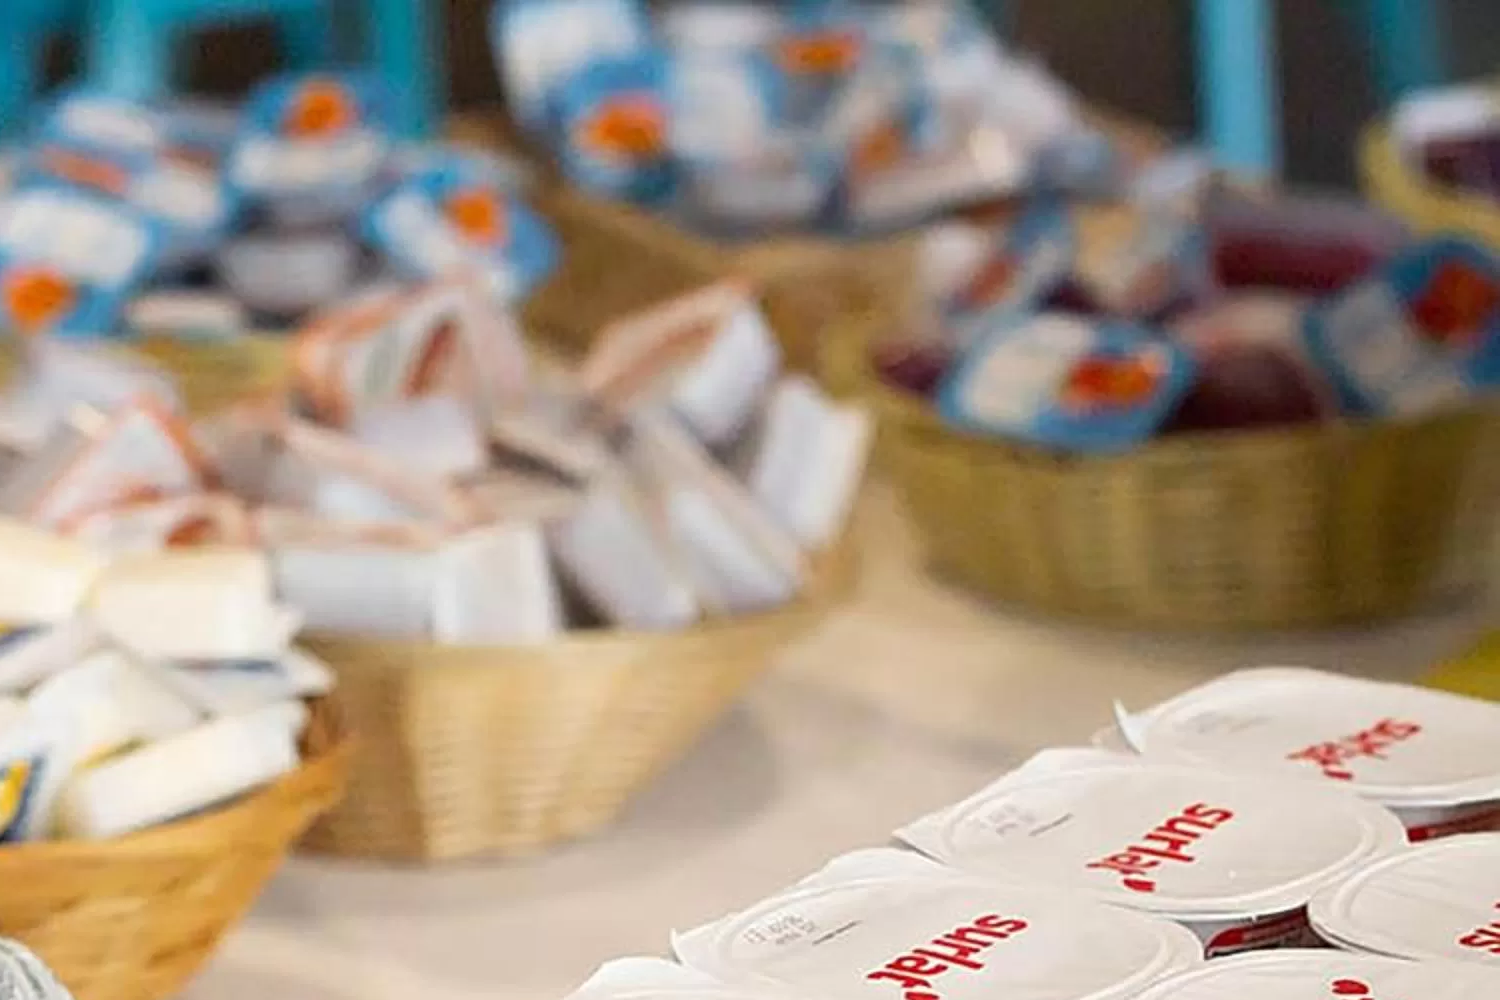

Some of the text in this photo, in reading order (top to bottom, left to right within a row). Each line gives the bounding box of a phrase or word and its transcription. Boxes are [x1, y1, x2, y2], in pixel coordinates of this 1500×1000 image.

[1287, 719, 1420, 767] surlat
[1087, 802, 1235, 883] surlat
[867, 913, 1029, 1000] surlat
